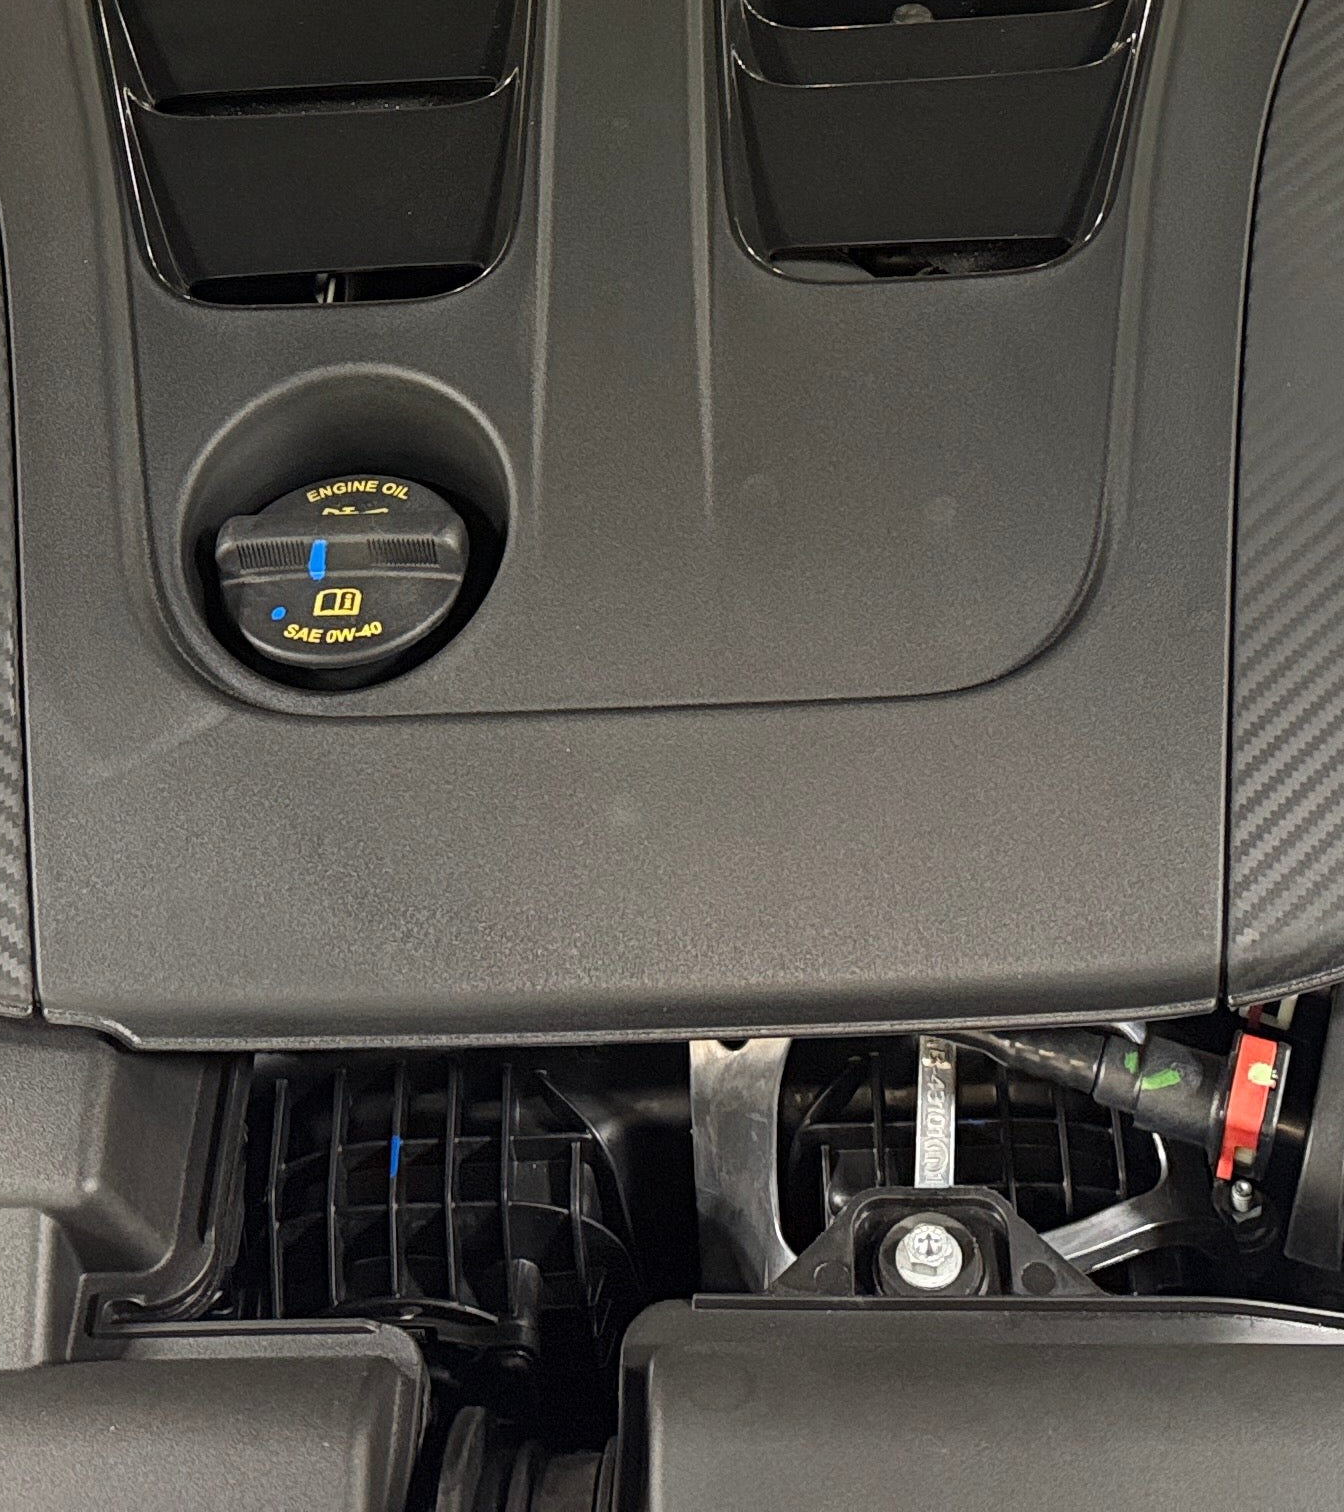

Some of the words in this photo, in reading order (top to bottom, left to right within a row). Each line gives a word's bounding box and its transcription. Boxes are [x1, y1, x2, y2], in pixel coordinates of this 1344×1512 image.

[306, 480, 379, 503] ENGINE
[381, 481, 409, 500] OIL
[283, 624, 322, 643] SAE
[325, 621, 382, 644] 0W-40
